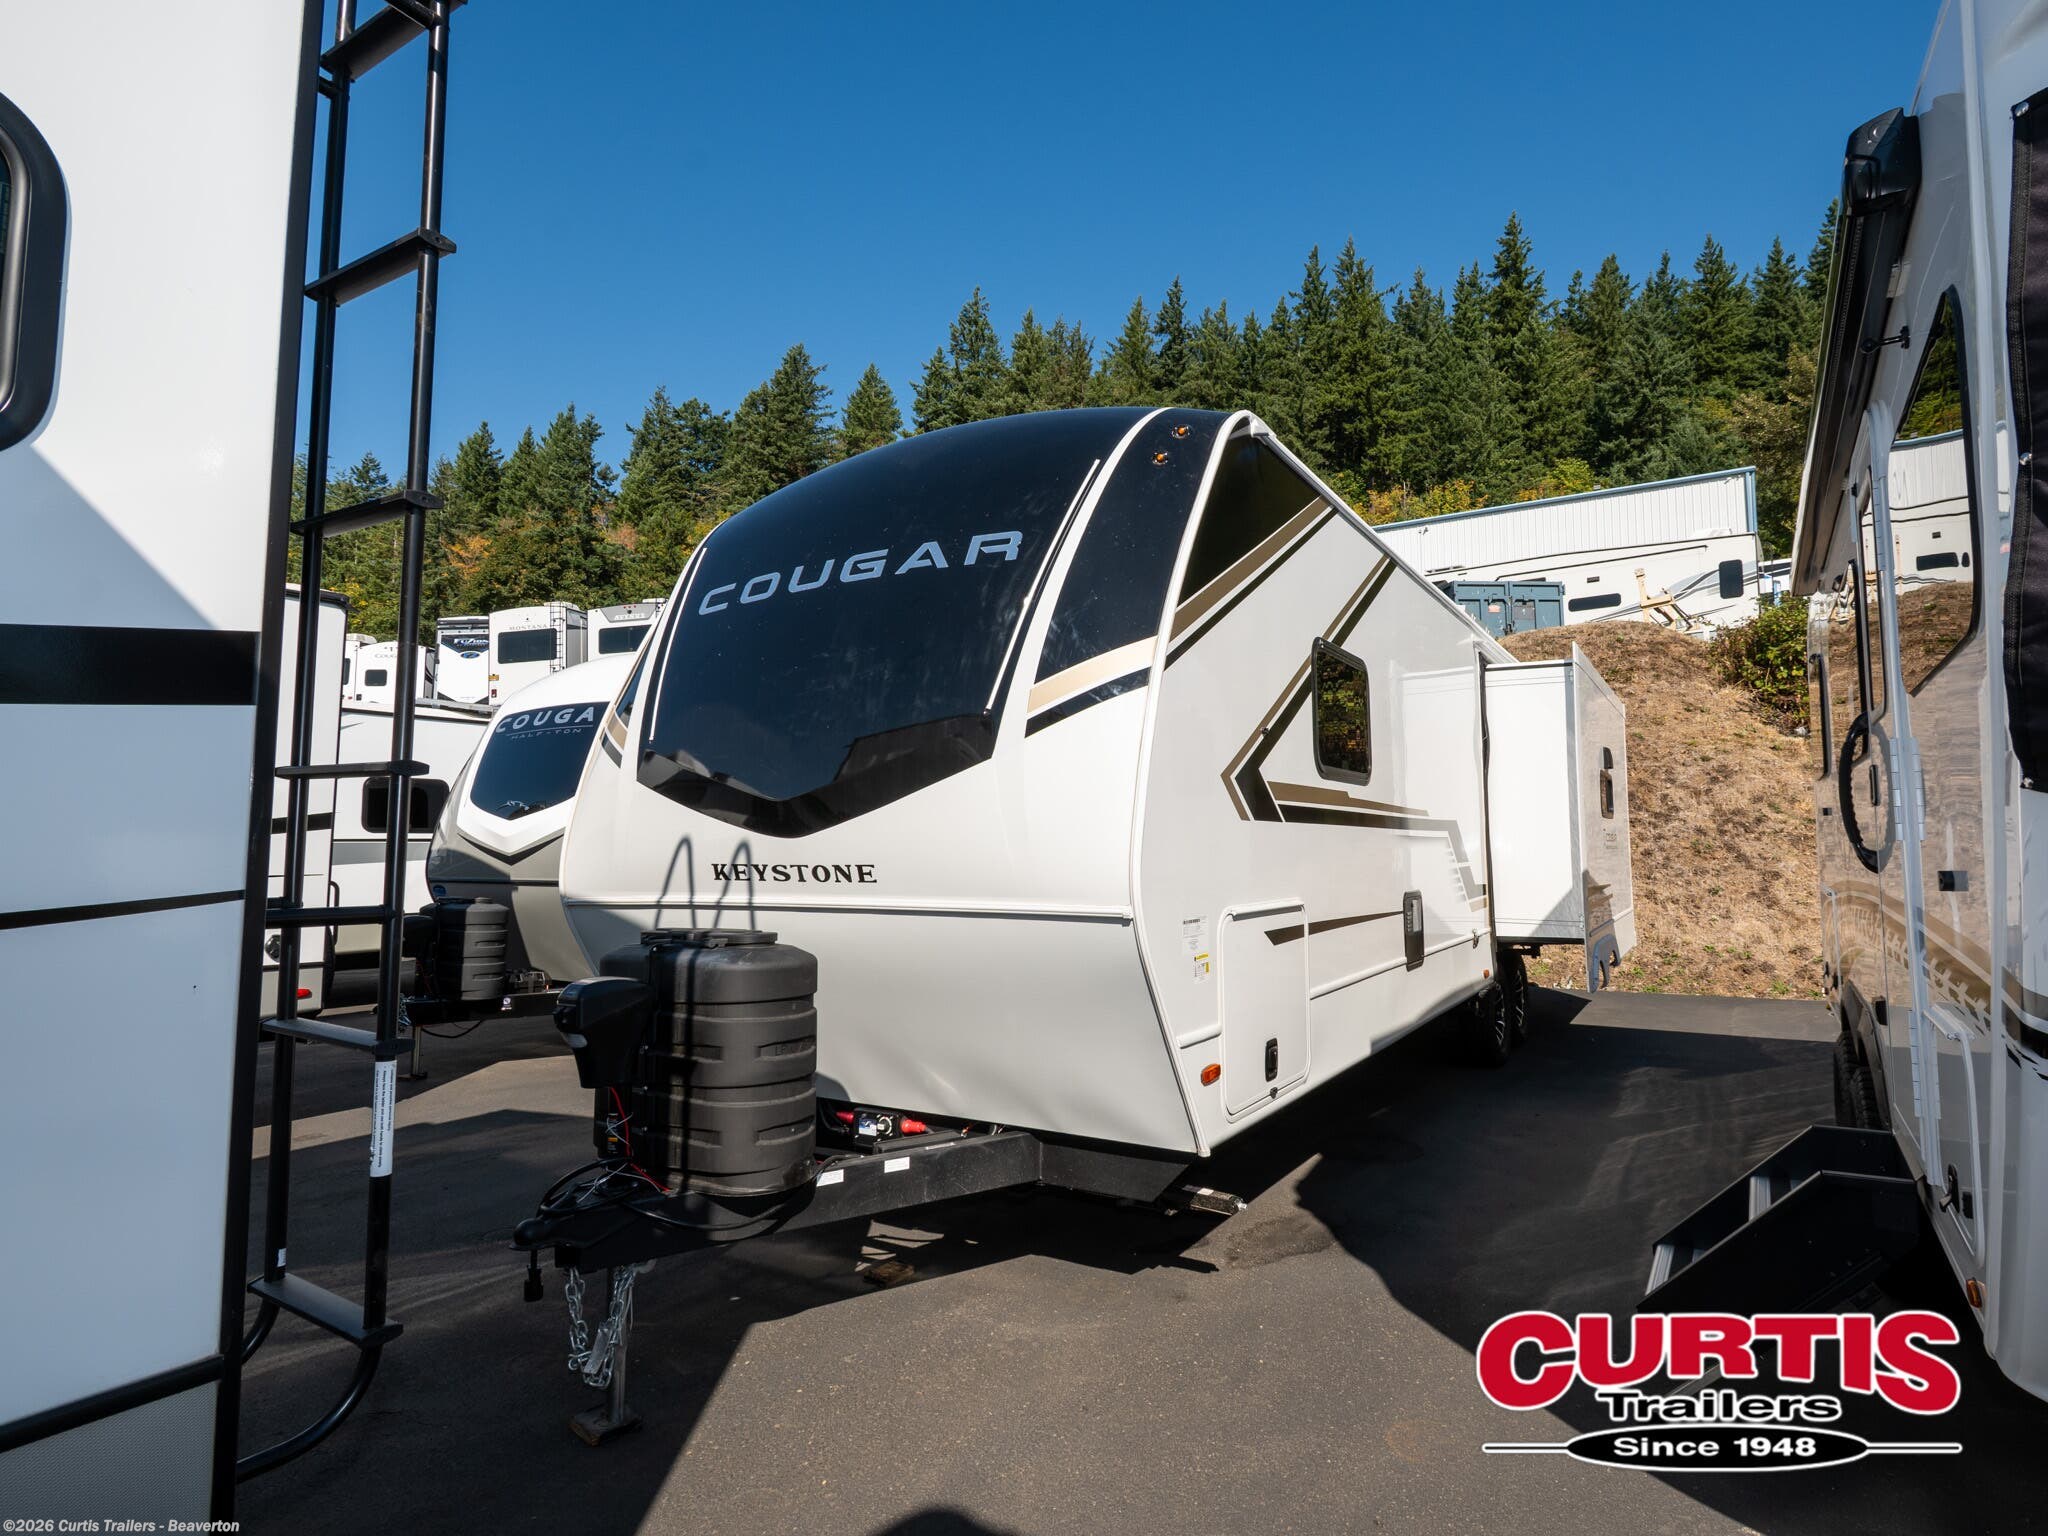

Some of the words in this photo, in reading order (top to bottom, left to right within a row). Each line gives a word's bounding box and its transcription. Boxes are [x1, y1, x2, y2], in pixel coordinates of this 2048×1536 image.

[698, 530, 1024, 616] COUGAR
[495, 706, 595, 733] COUGA
[711, 863, 878, 883] KEYSTONE
